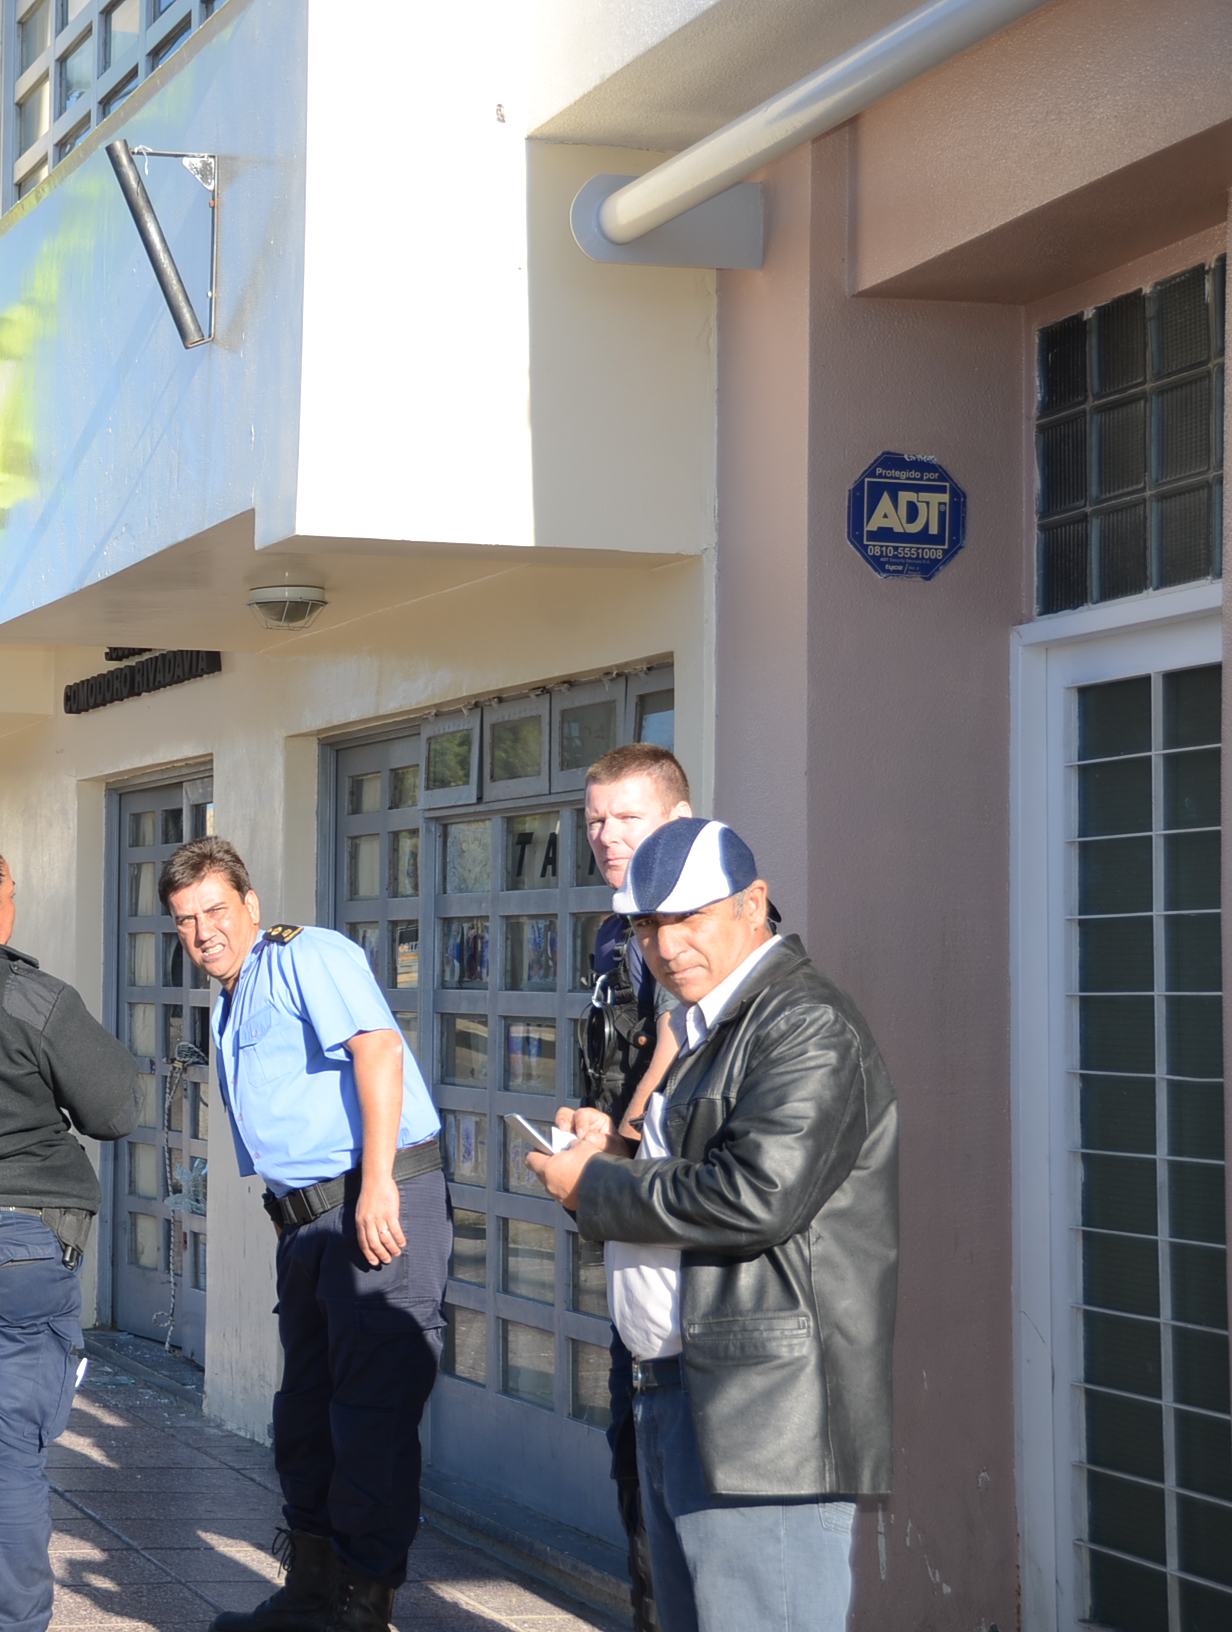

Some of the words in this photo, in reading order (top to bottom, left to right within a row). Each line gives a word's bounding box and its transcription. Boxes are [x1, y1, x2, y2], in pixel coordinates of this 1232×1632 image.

[875, 467, 921, 480] Protegido
[923, 471, 939, 480] por
[865, 490, 949, 535] ADT
[867, 545, 943, 559] 0810-5551008
[64, 665, 132, 714] COMODORO
[134, 650, 216, 695] RIVADAVIA
